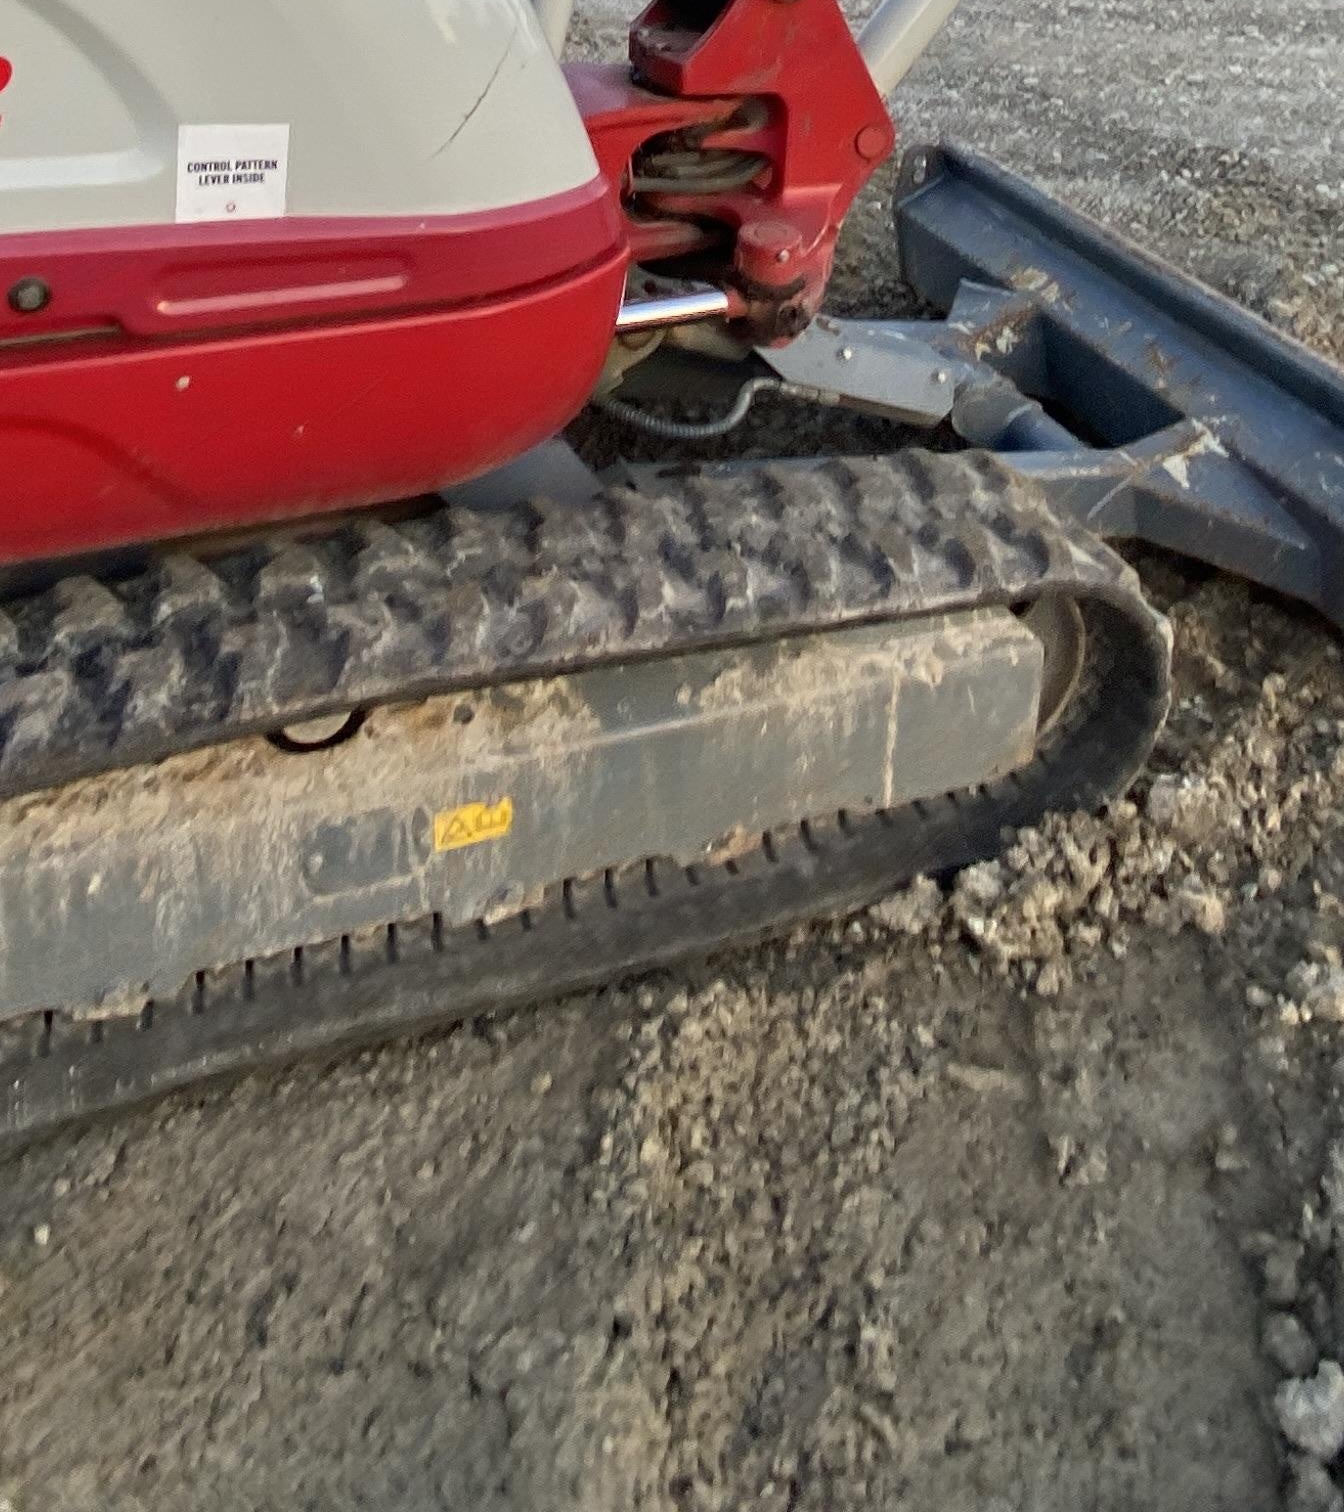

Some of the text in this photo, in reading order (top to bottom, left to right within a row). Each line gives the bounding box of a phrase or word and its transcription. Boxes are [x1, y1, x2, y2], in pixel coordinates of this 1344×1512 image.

[187, 159, 278, 173] CONTROL PATTERN
[198, 172, 265, 186] LEVER INSIDE
